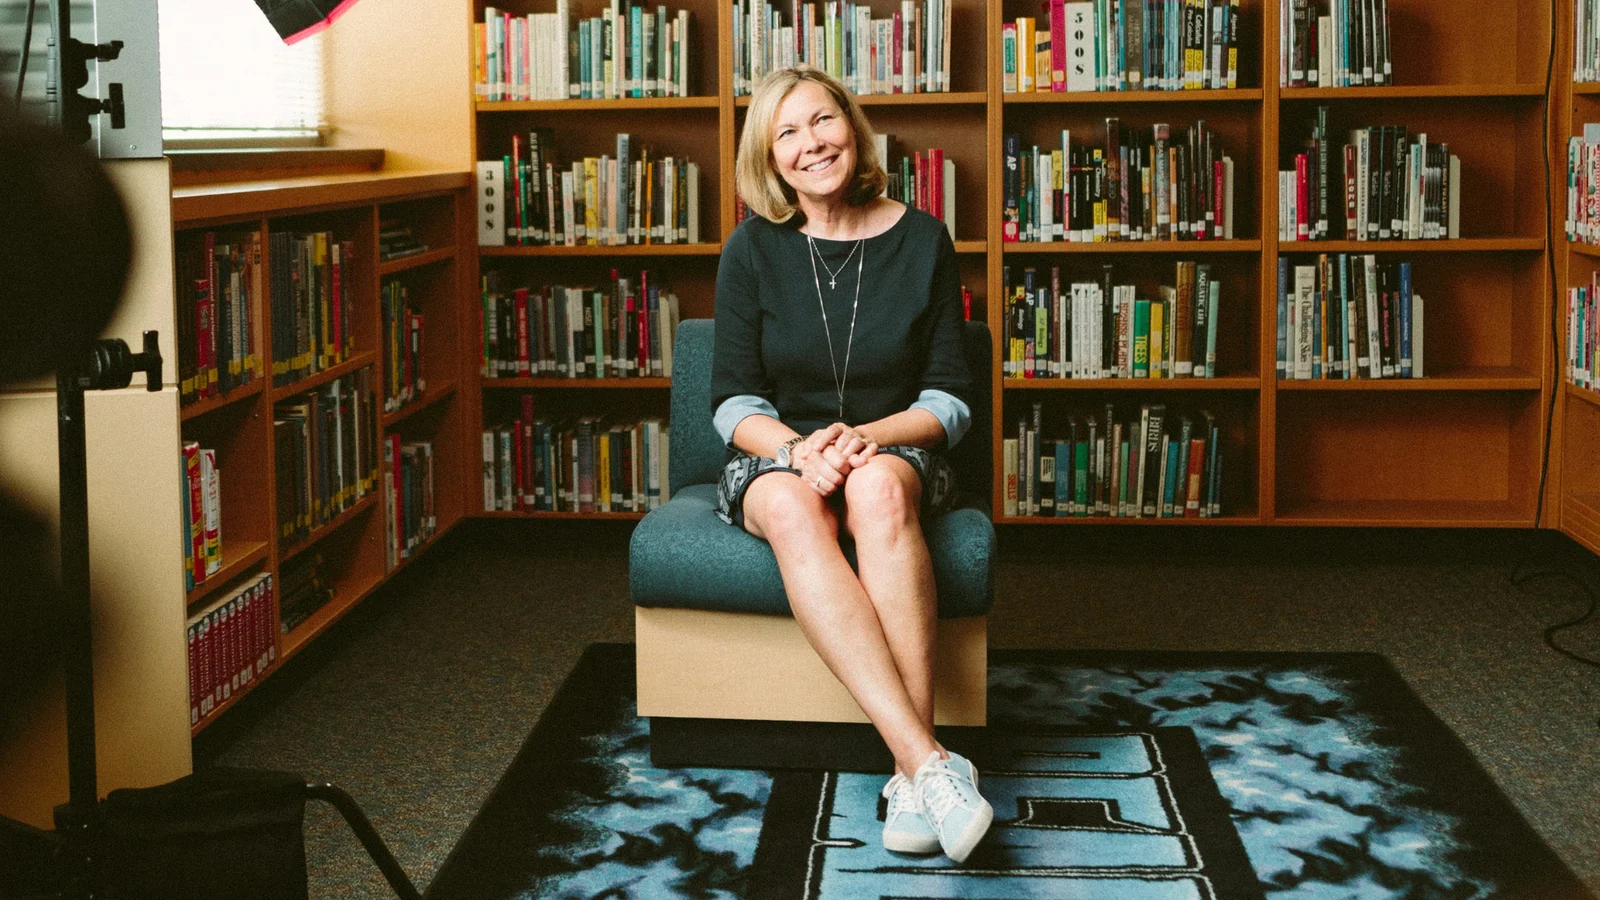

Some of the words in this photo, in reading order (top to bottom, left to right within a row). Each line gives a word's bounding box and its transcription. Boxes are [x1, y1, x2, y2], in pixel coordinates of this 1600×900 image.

[1075, 12, 1085, 75] 500S
[1007, 156, 1017, 171] AP
[485, 170, 495, 230] 300S
[1026, 291, 1035, 305] AP
[1198, 271, 1206, 307] AQUATIC
[1301, 284, 1312, 299] The
[1299, 300, 1312, 345] Challenging
[1038, 328, 1046, 348] Biology
[1135, 334, 1148, 364] TREES
[1148, 416, 1161, 453] BIRDS
[1008, 473, 1017, 500] SHELLS
